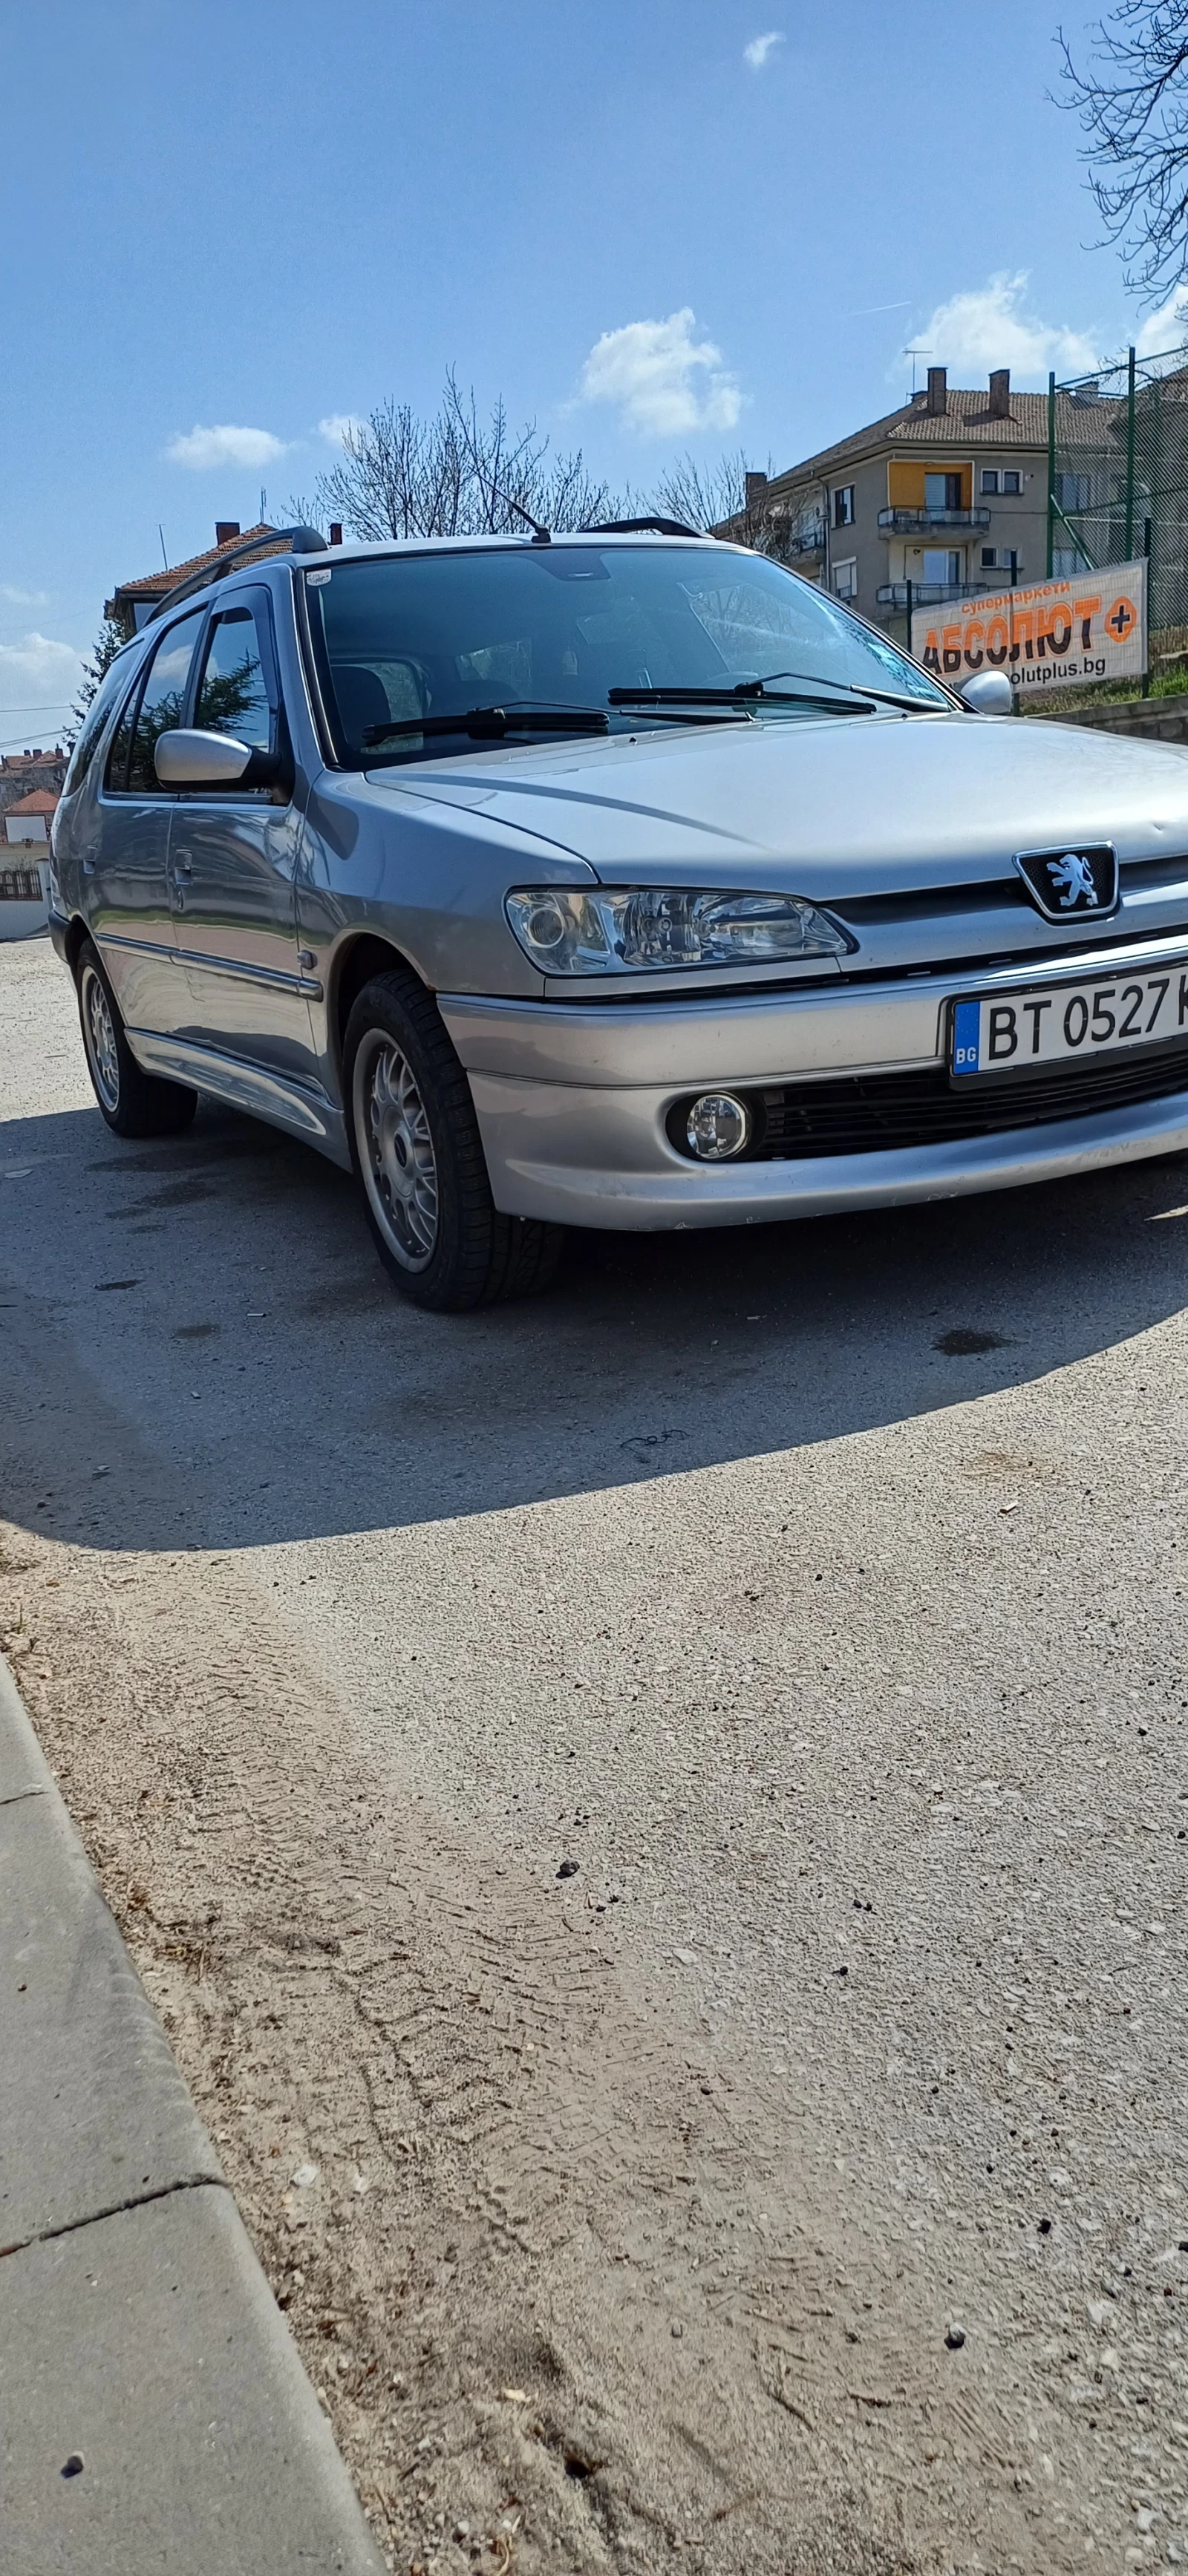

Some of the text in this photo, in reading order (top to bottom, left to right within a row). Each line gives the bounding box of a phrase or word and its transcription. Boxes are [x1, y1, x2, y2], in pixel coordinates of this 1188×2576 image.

[962, 581, 1070, 614] супермаркети
[923, 596, 1101, 675] АБСОЛЮТ
[1008, 657, 1106, 685] olutplus.bg
[989, 1000, 1052, 1060] BT
[1063, 978, 1170, 1047] 0527
[956, 1047, 976, 1065] BG
